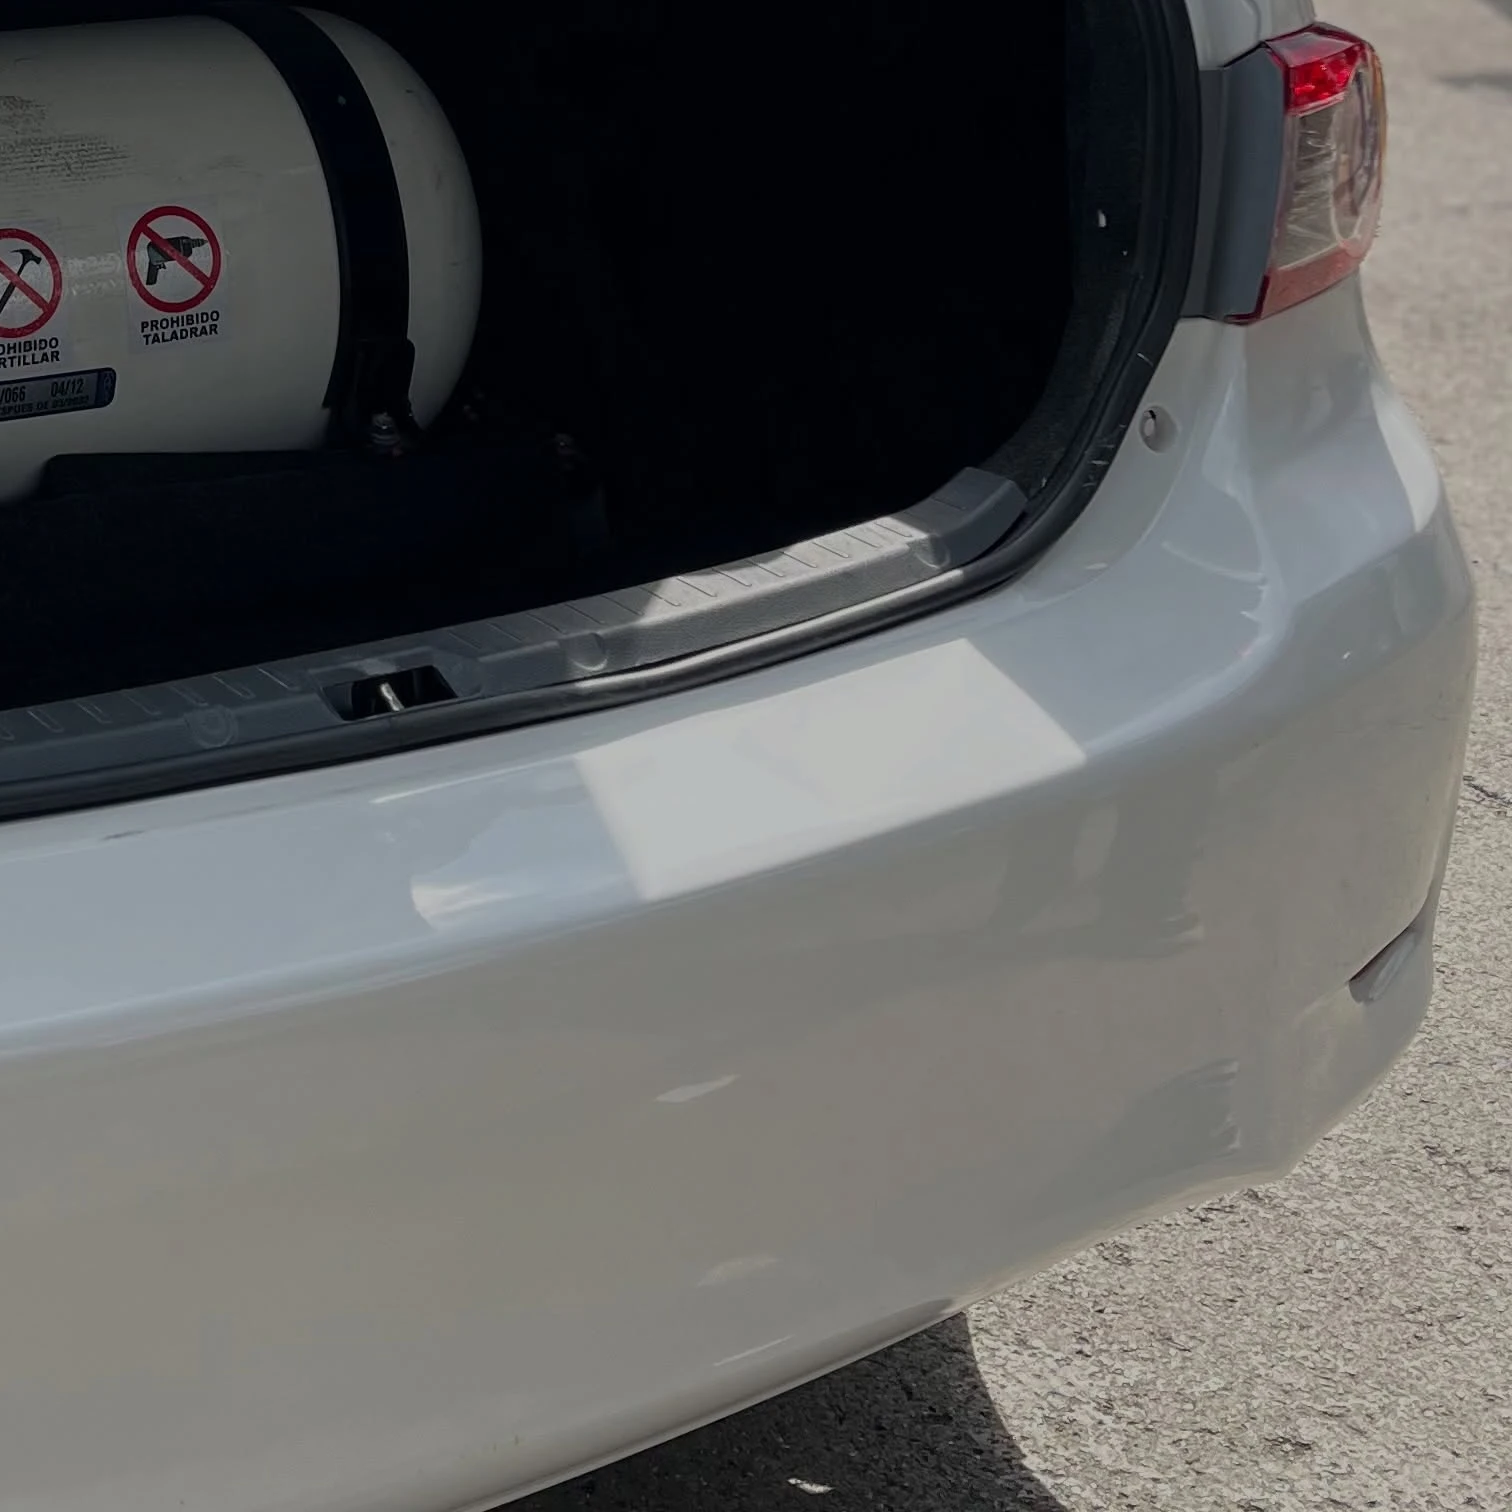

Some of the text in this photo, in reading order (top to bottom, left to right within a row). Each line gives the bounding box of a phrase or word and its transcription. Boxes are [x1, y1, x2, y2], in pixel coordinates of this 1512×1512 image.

[140, 310, 220, 333] PROHIBIDO
[142, 323, 218, 346] TALADRAR
[50, 378, 85, 398] 04/12
